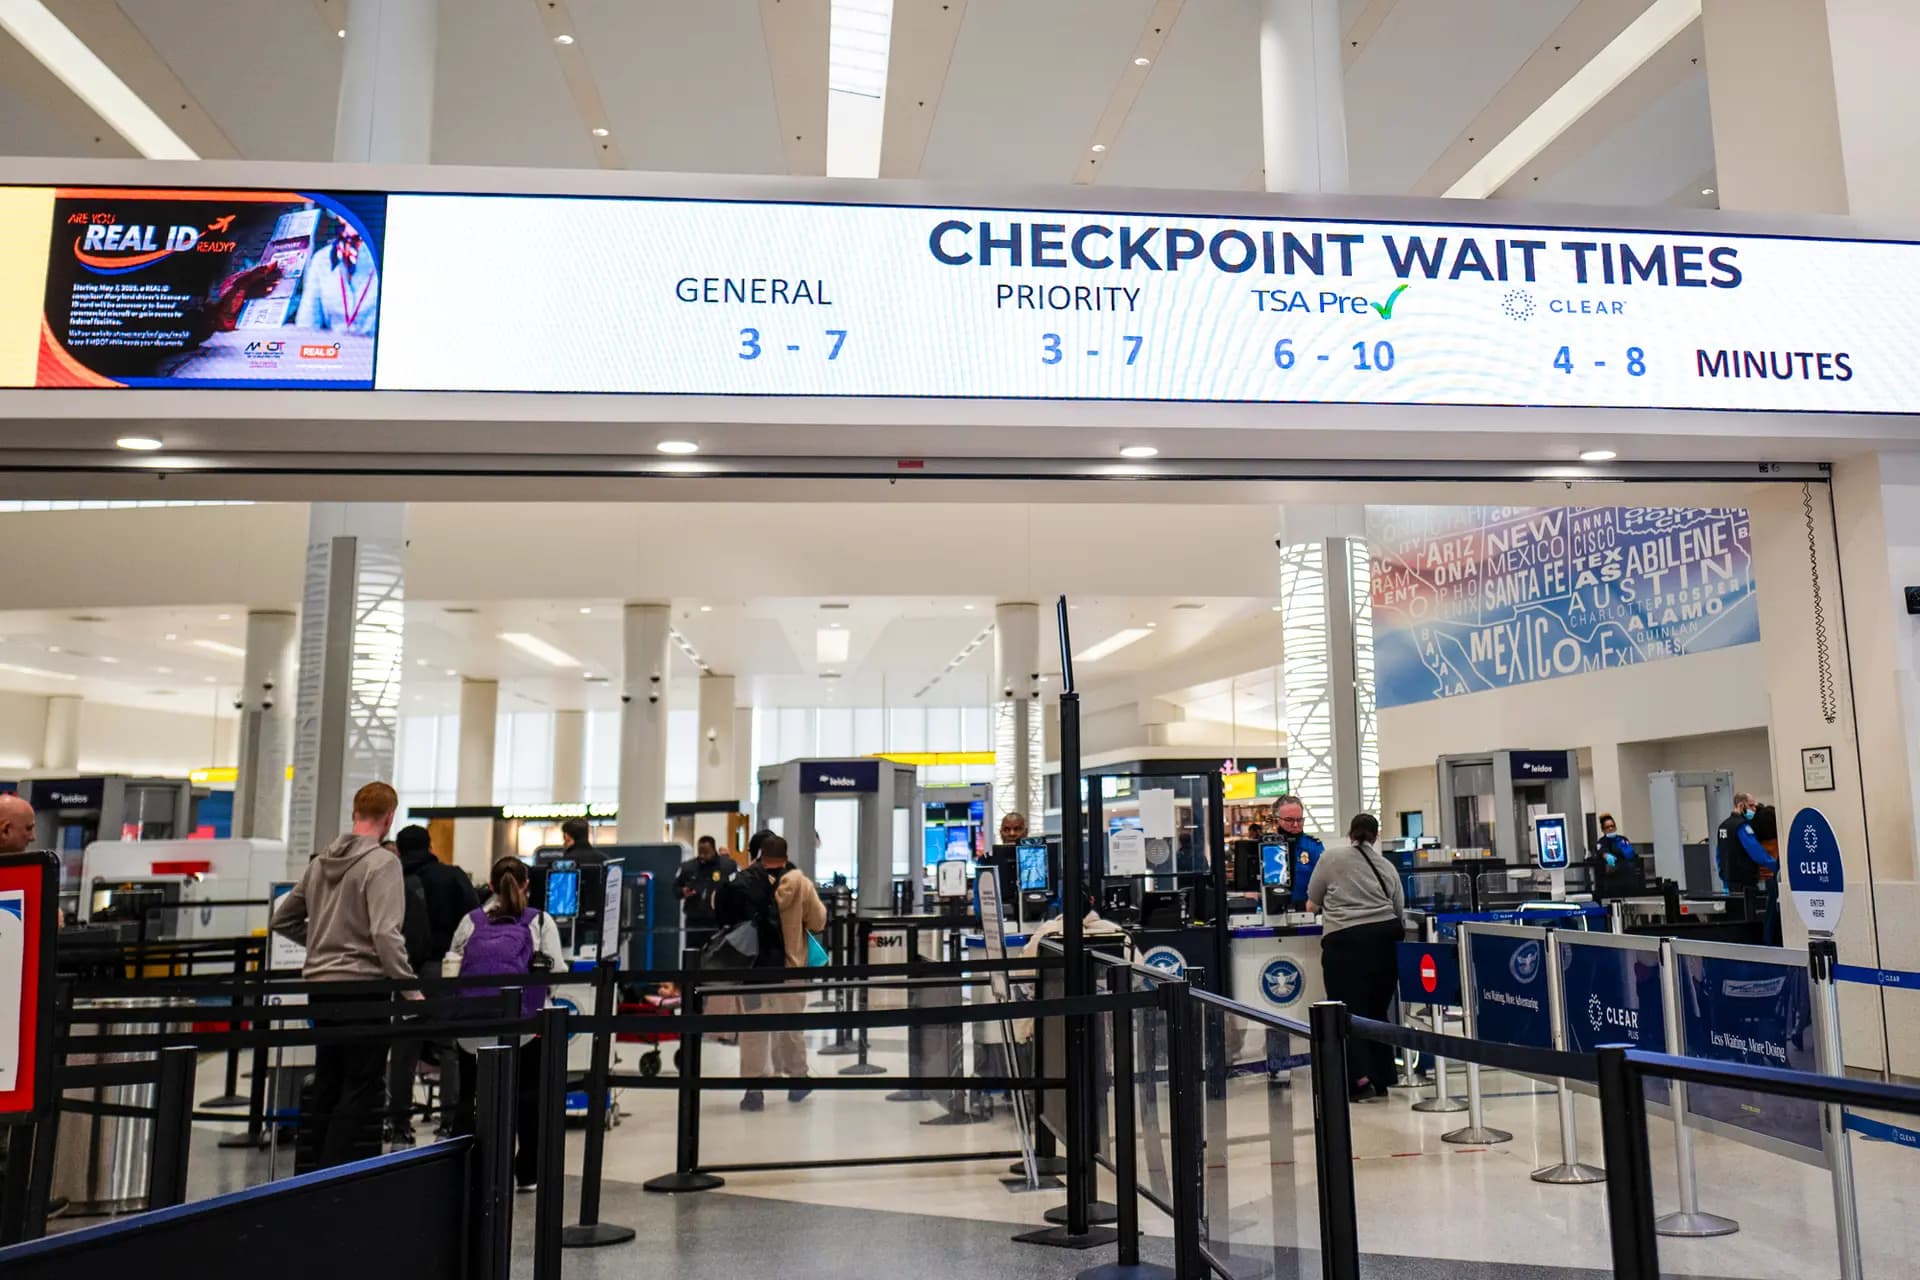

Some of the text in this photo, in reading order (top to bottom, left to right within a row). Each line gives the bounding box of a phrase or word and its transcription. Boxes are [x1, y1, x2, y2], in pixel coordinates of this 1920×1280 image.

[68, 213, 116, 224] ARE YOU
[83, 224, 199, 251] REAL ID
[197, 241, 236, 253] READY?
[929, 220, 1743, 288] CHECKPOINT WAIT TIMES
[675, 277, 832, 305] GENERAL
[996, 283, 1142, 312] PRIORITY
[1252, 289, 1368, 315] TSA Pre
[1549, 299, 1624, 315] CLEAR
[738, 327, 762, 360] 3
[825, 330, 848, 360] 7
[1041, 333, 1064, 365] 3
[1123, 335, 1144, 366] 7
[1273, 337, 1296, 370] 6
[1352, 339, 1396, 371] 10
[1552, 345, 1574, 374] 4
[1626, 346, 1647, 376] 8
[1696, 348, 1853, 381] MINUTES
[1487, 511, 1563, 556] NEW
[1573, 511, 1612, 535] ANNA
[1426, 534, 1474, 568] ARIZ
[1487, 536, 1564, 576] MEXICO
[1574, 526, 1615, 557] CISCO
[1625, 521, 1729, 578] ABILENE
[1434, 557, 1477, 586] ONA
[1572, 547, 1623, 572] TEX
[1372, 568, 1410, 595] RAM
[1439, 579, 1477, 601] PHO
[1485, 559, 1566, 610] SANTA FE
[1575, 563, 1621, 590] AS
[1384, 583, 1419, 605] ENT
[1654, 579, 1740, 609] PROSPER
[1570, 598, 1651, 628] CHARLOTTE
[1628, 597, 1723, 632] ALAMO
[1637, 621, 1698, 642] QUINLAN
[1469, 614, 1581, 683] MEXICO
[829, 776, 856, 786] leidos
[1531, 764, 1553, 773] leidos
[1800, 861, 1828, 874] CLEAR
[876, 935, 903, 948] BWI
[1606, 1006, 1638, 1029] CLEAR
[1710, 1030, 1724, 1047] Less
[1748, 1038, 1765, 1054] More
[1765, 1040, 1786, 1063] Doing
